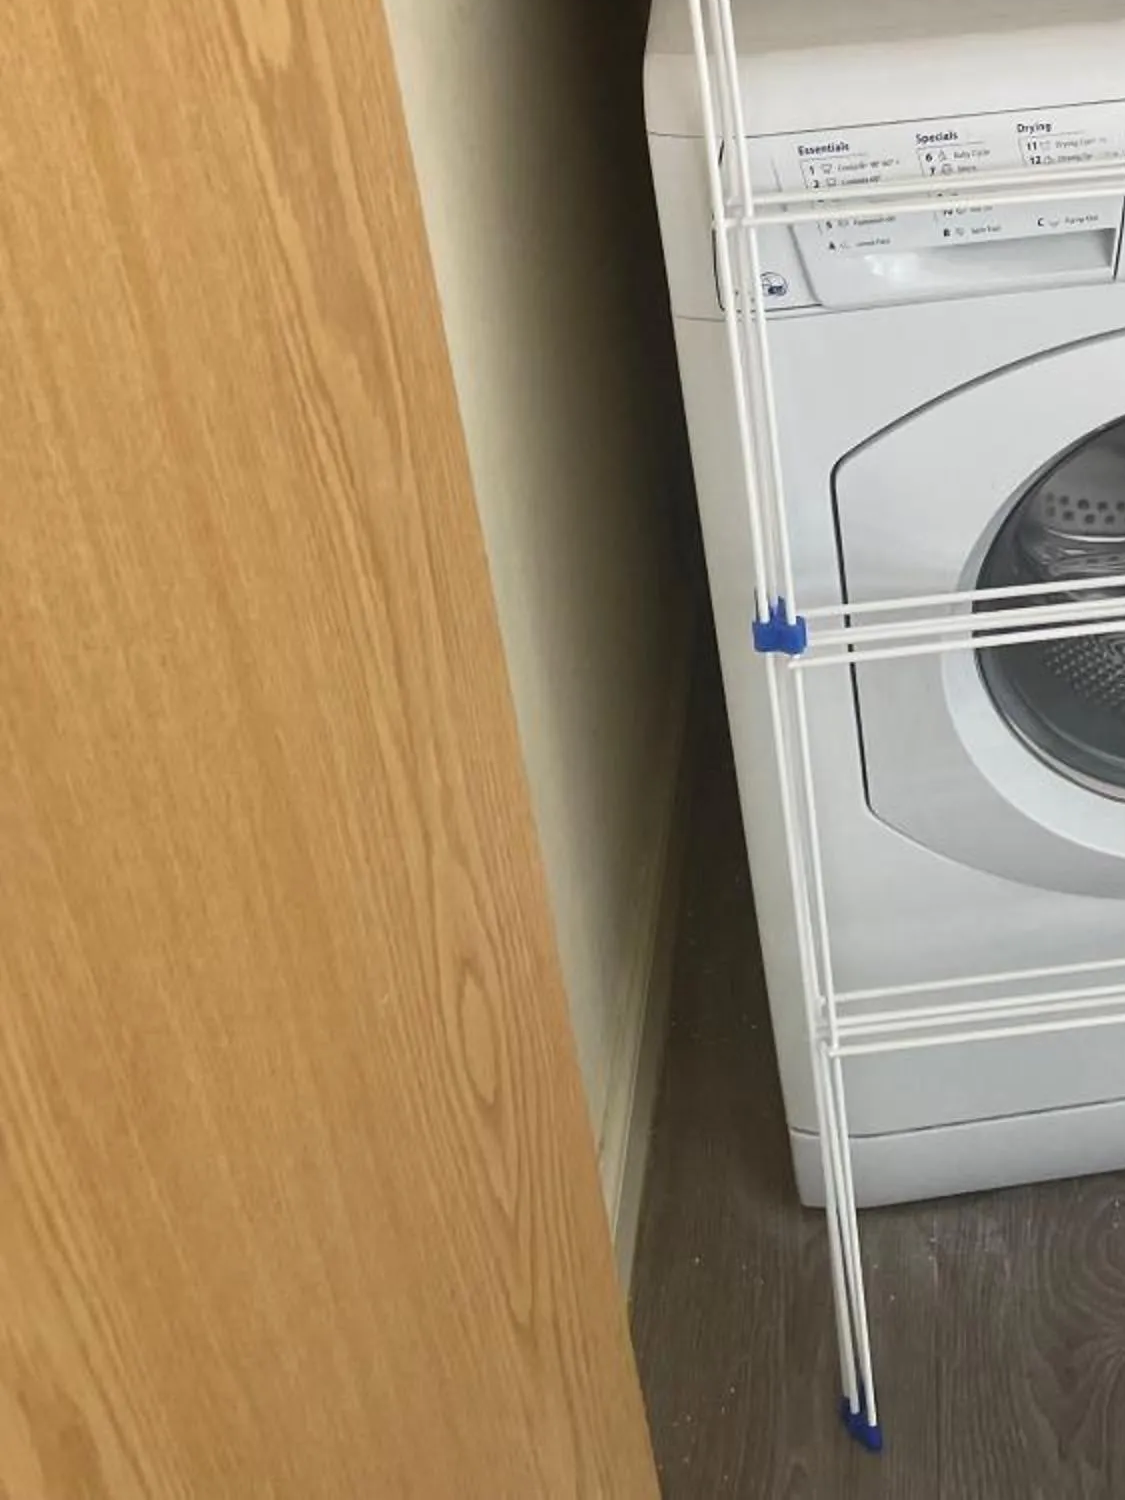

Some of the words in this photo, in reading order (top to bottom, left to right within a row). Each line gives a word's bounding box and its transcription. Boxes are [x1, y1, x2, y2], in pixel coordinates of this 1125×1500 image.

[1017, 122, 1052, 135] Drying
[915, 130, 959, 145] Specials
[797, 140, 850, 157] Essentials
[1026, 140, 1038, 152] 11
[1029, 155, 1042, 165] 12
